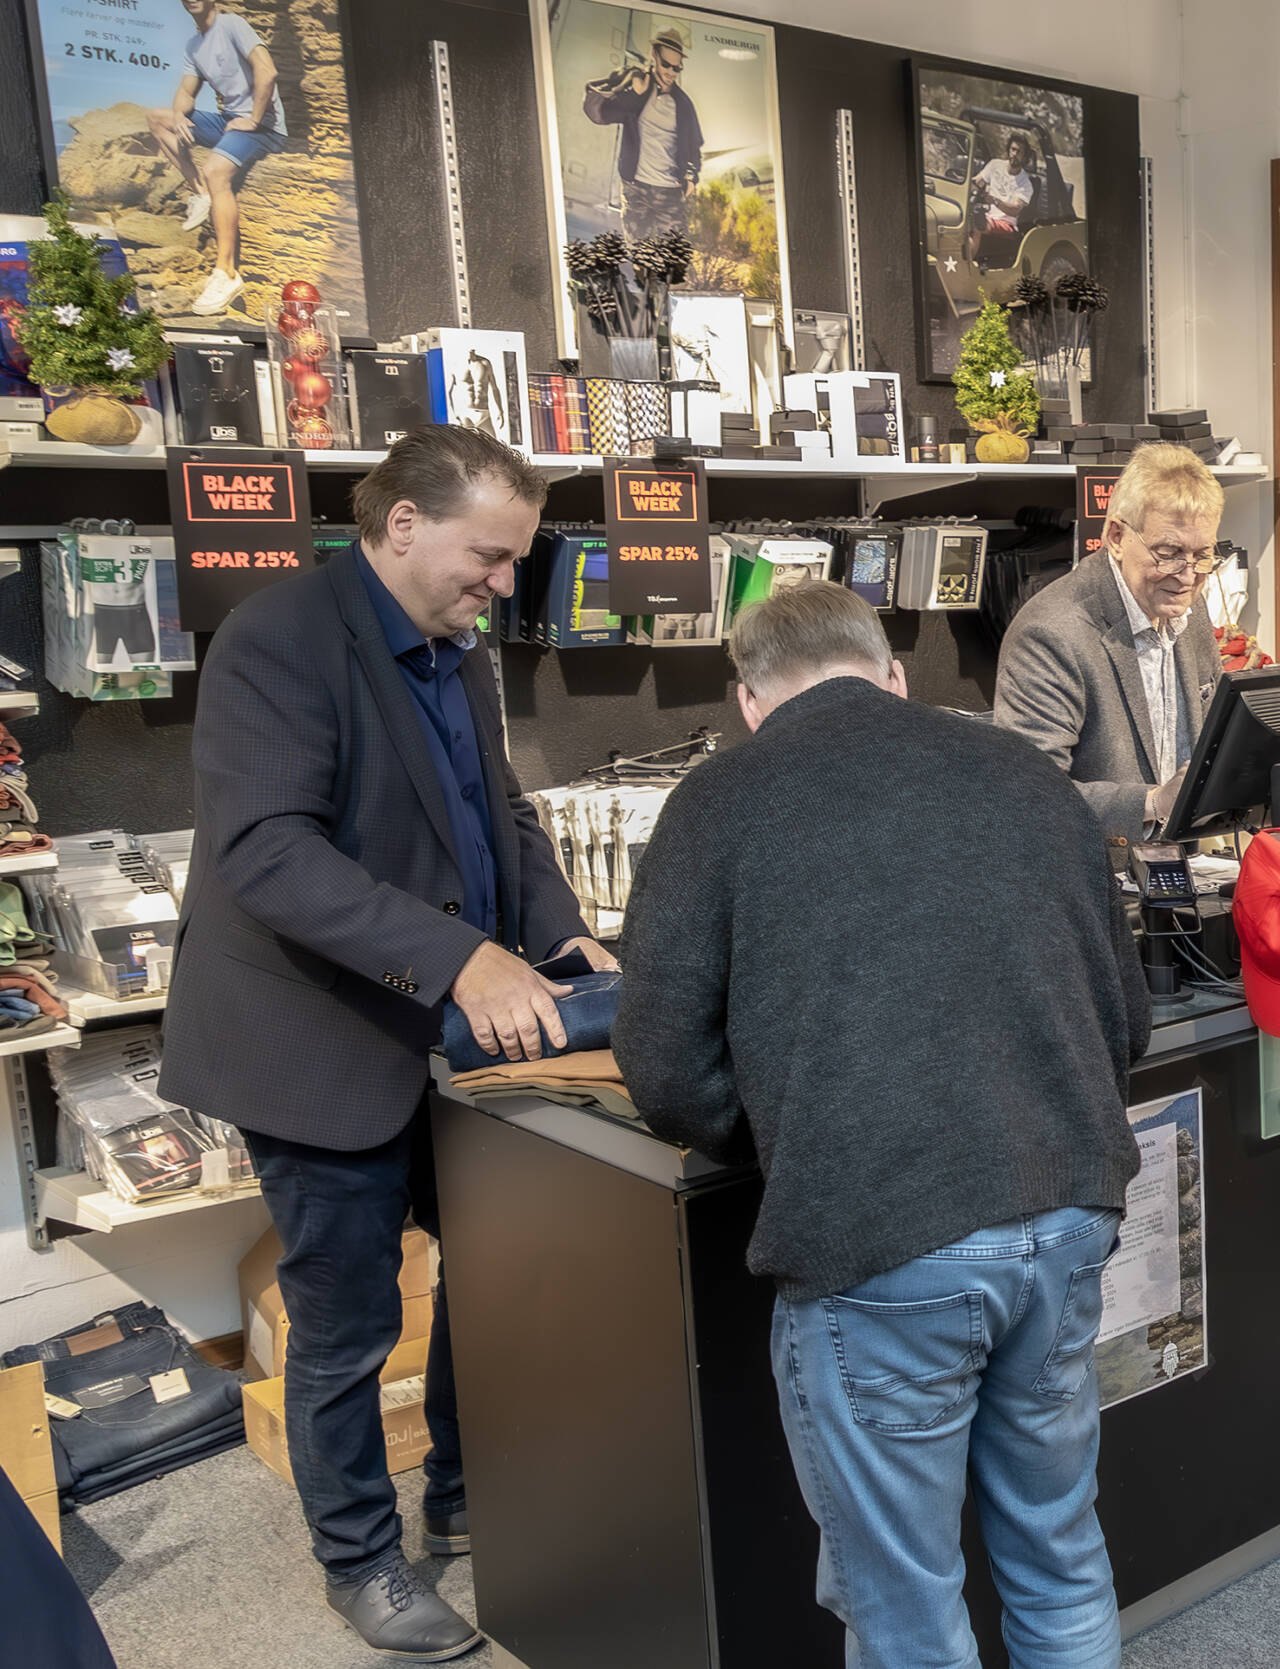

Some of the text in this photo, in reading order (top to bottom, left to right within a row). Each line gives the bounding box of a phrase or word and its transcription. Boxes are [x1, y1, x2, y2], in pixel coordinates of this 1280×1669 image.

[87, 0, 139, 11] -SHIRT
[64, 42, 171, 71] 2 STK. 400,-
[202, 475, 276, 493] BLACK
[628, 480, 683, 497] BLACK
[1093, 484, 1115, 497] BLA
[208, 493, 274, 511] WEEK
[632, 496, 681, 512] WEEK
[191, 551, 299, 569] SPAR 25%
[619, 546, 699, 561] SPAR 25%
